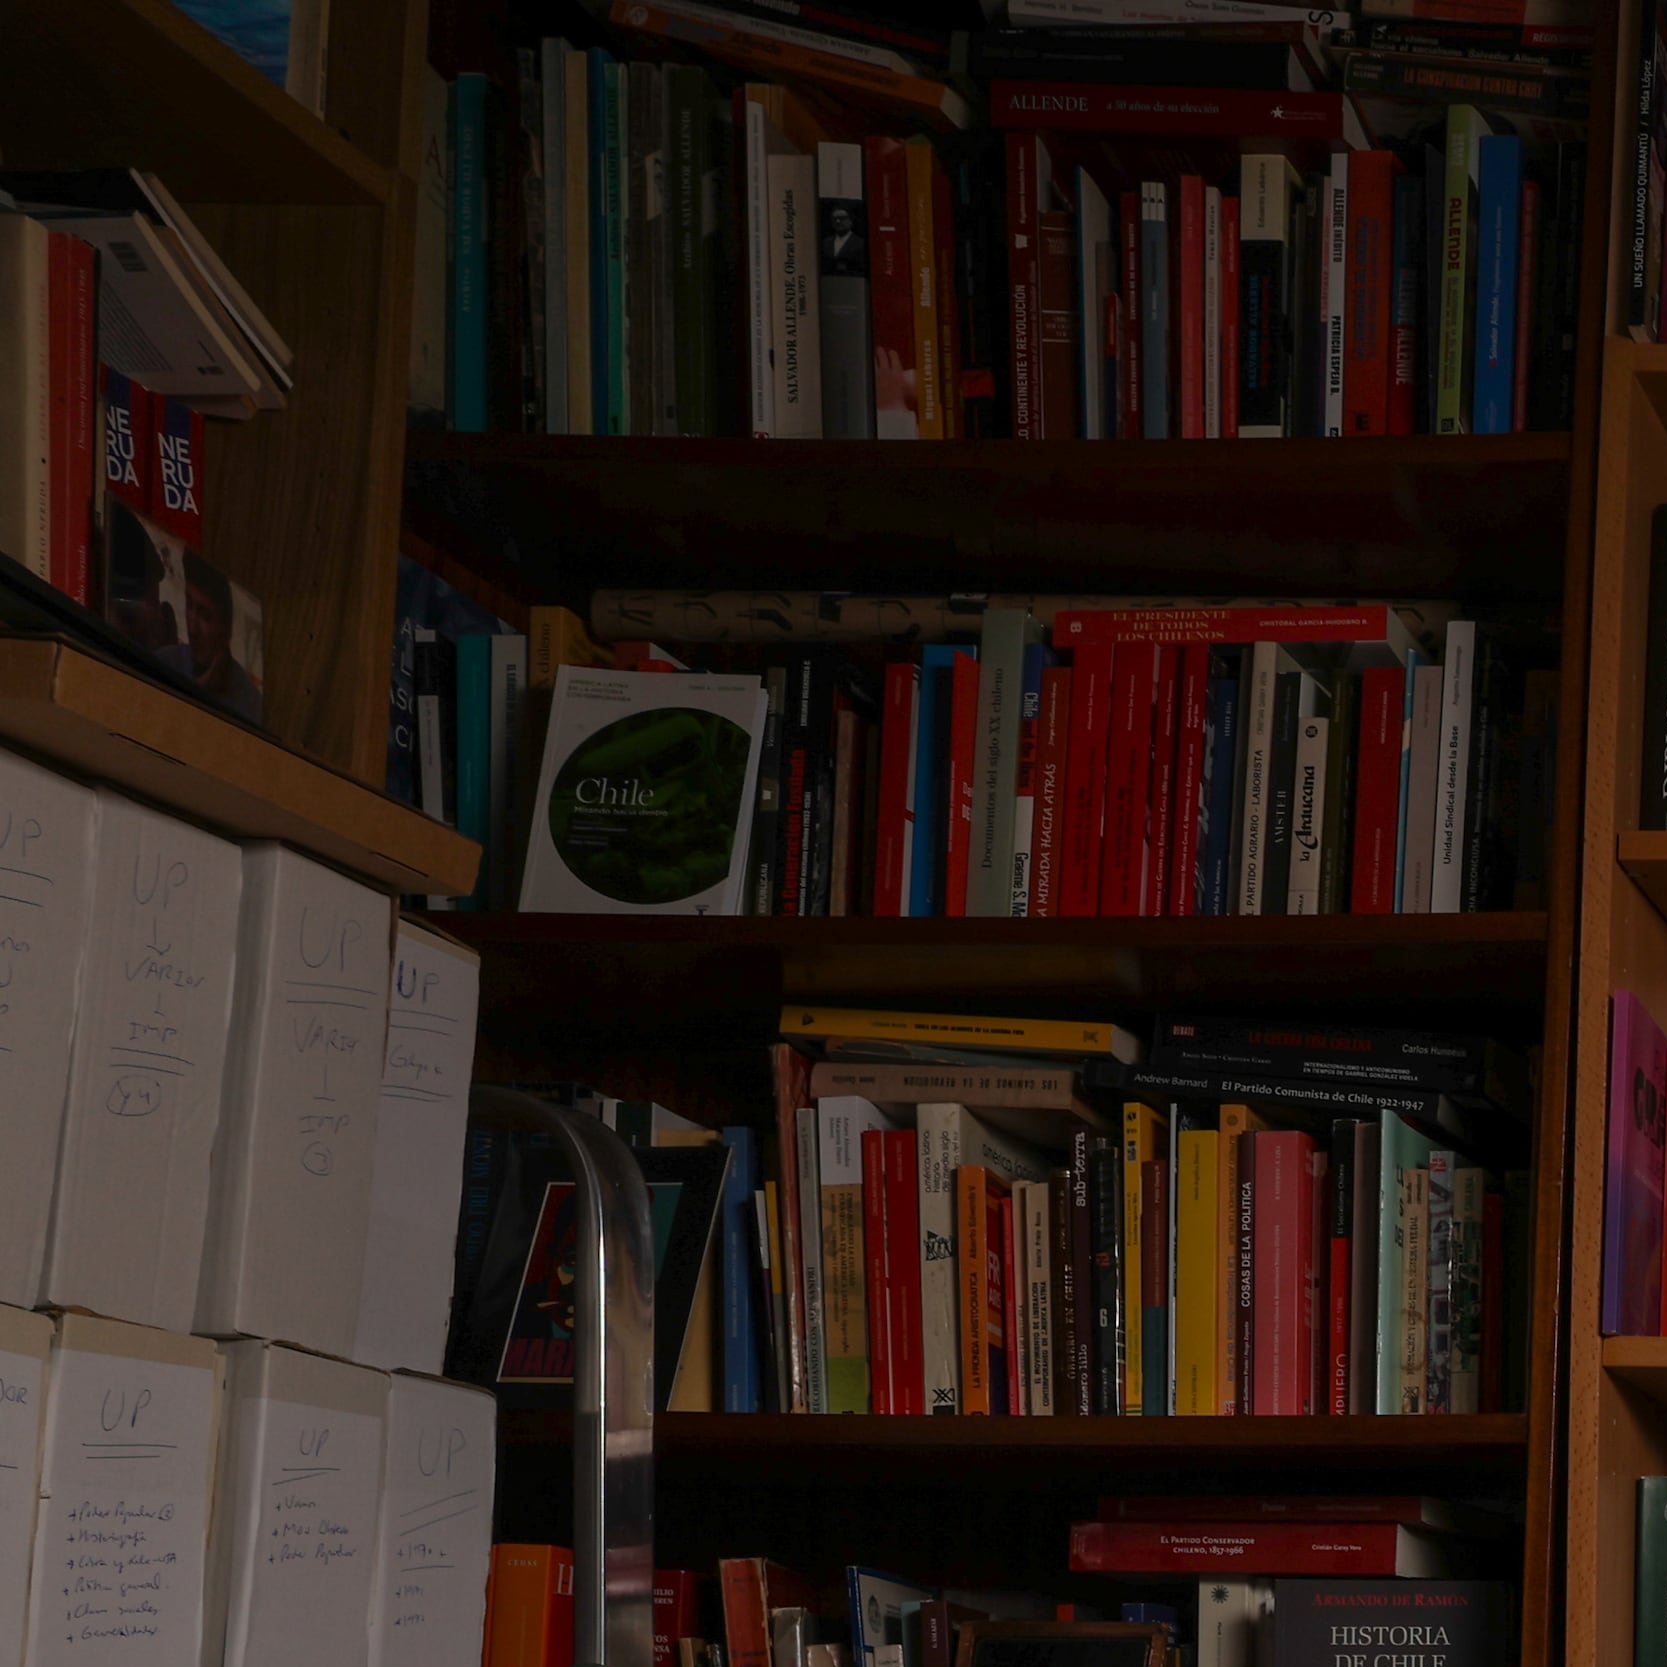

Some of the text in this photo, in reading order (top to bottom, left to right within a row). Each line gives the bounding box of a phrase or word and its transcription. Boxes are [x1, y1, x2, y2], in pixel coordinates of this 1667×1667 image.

[1009, 94, 1088, 112] ALLENDE
[158, 432, 193, 464] NE
[107, 455, 140, 488] DA
[161, 458, 195, 489] RU
[164, 483, 200, 517] DA
[575, 777, 655, 806] Chile
[134, 853, 189, 910] UP
[397, 960, 439, 1003] UP
[1221, 1080, 1424, 1111] El Partido Comunista de Chile 1922-1947
[101, 1388, 151, 1431] UP
[418, 1427, 466, 1480] UP
[1330, 1626, 1450, 1646] HISTORIA
